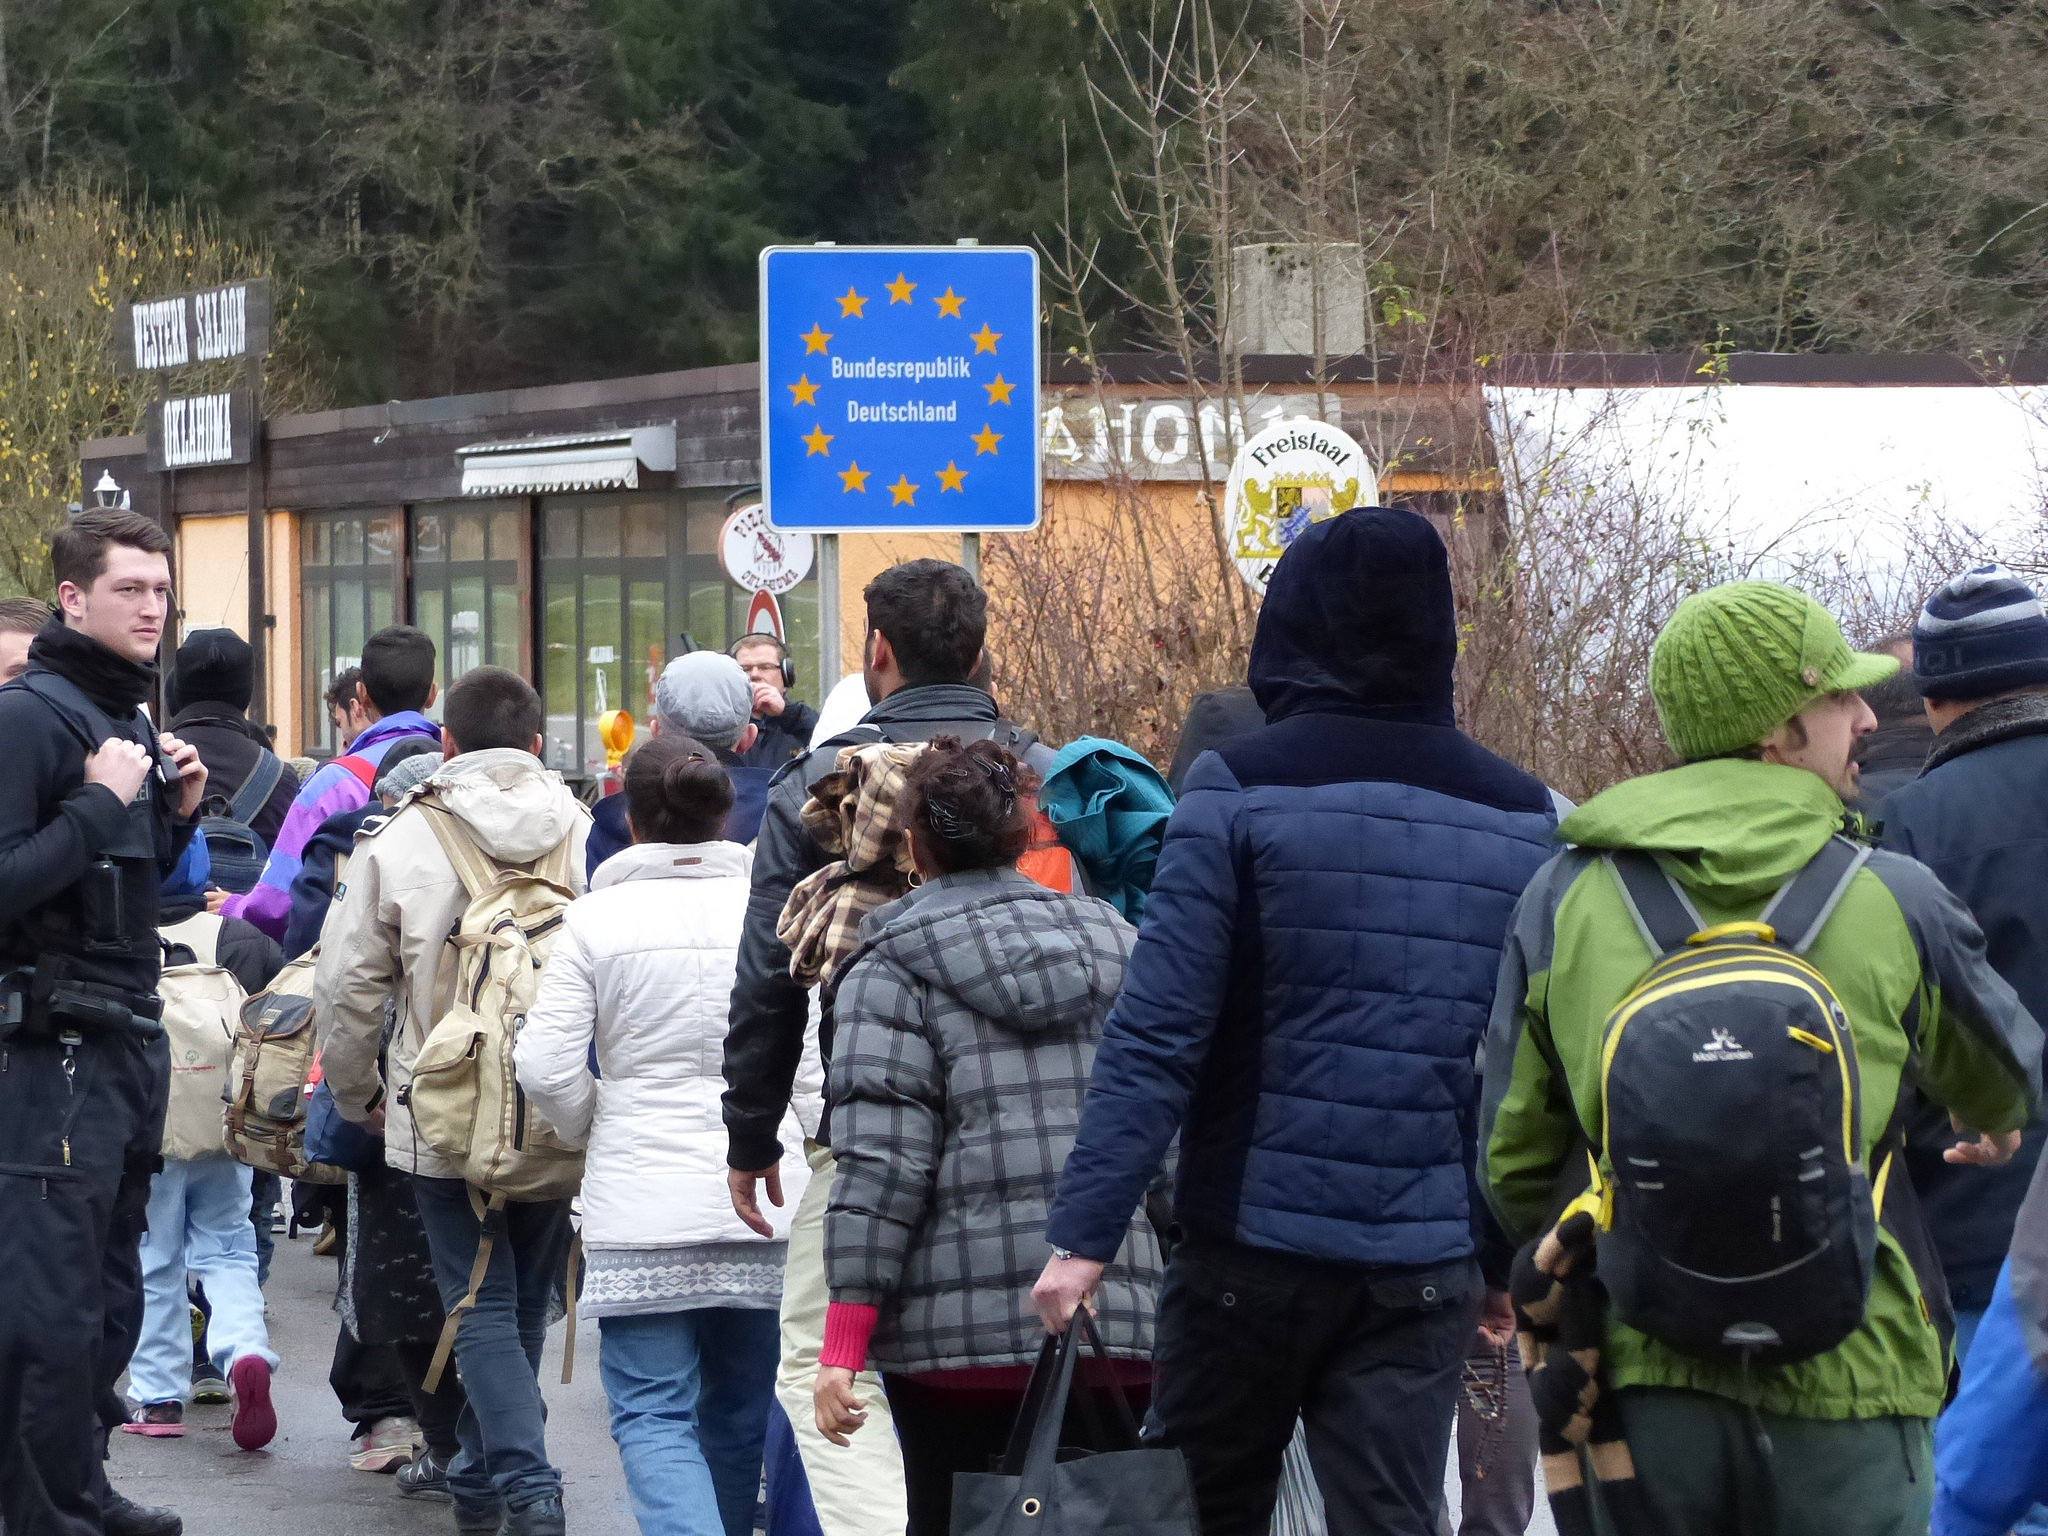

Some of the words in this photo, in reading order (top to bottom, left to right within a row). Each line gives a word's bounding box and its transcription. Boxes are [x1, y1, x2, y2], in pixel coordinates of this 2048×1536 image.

[132, 297, 189, 370] WESTERN
[195, 286, 246, 361] SALOON
[831, 356, 971, 383] Bundesrepublik
[164, 393, 232, 467] OKLAHOMA
[847, 400, 957, 423] Deutschland
[1250, 429, 1352, 468] Freistaat
